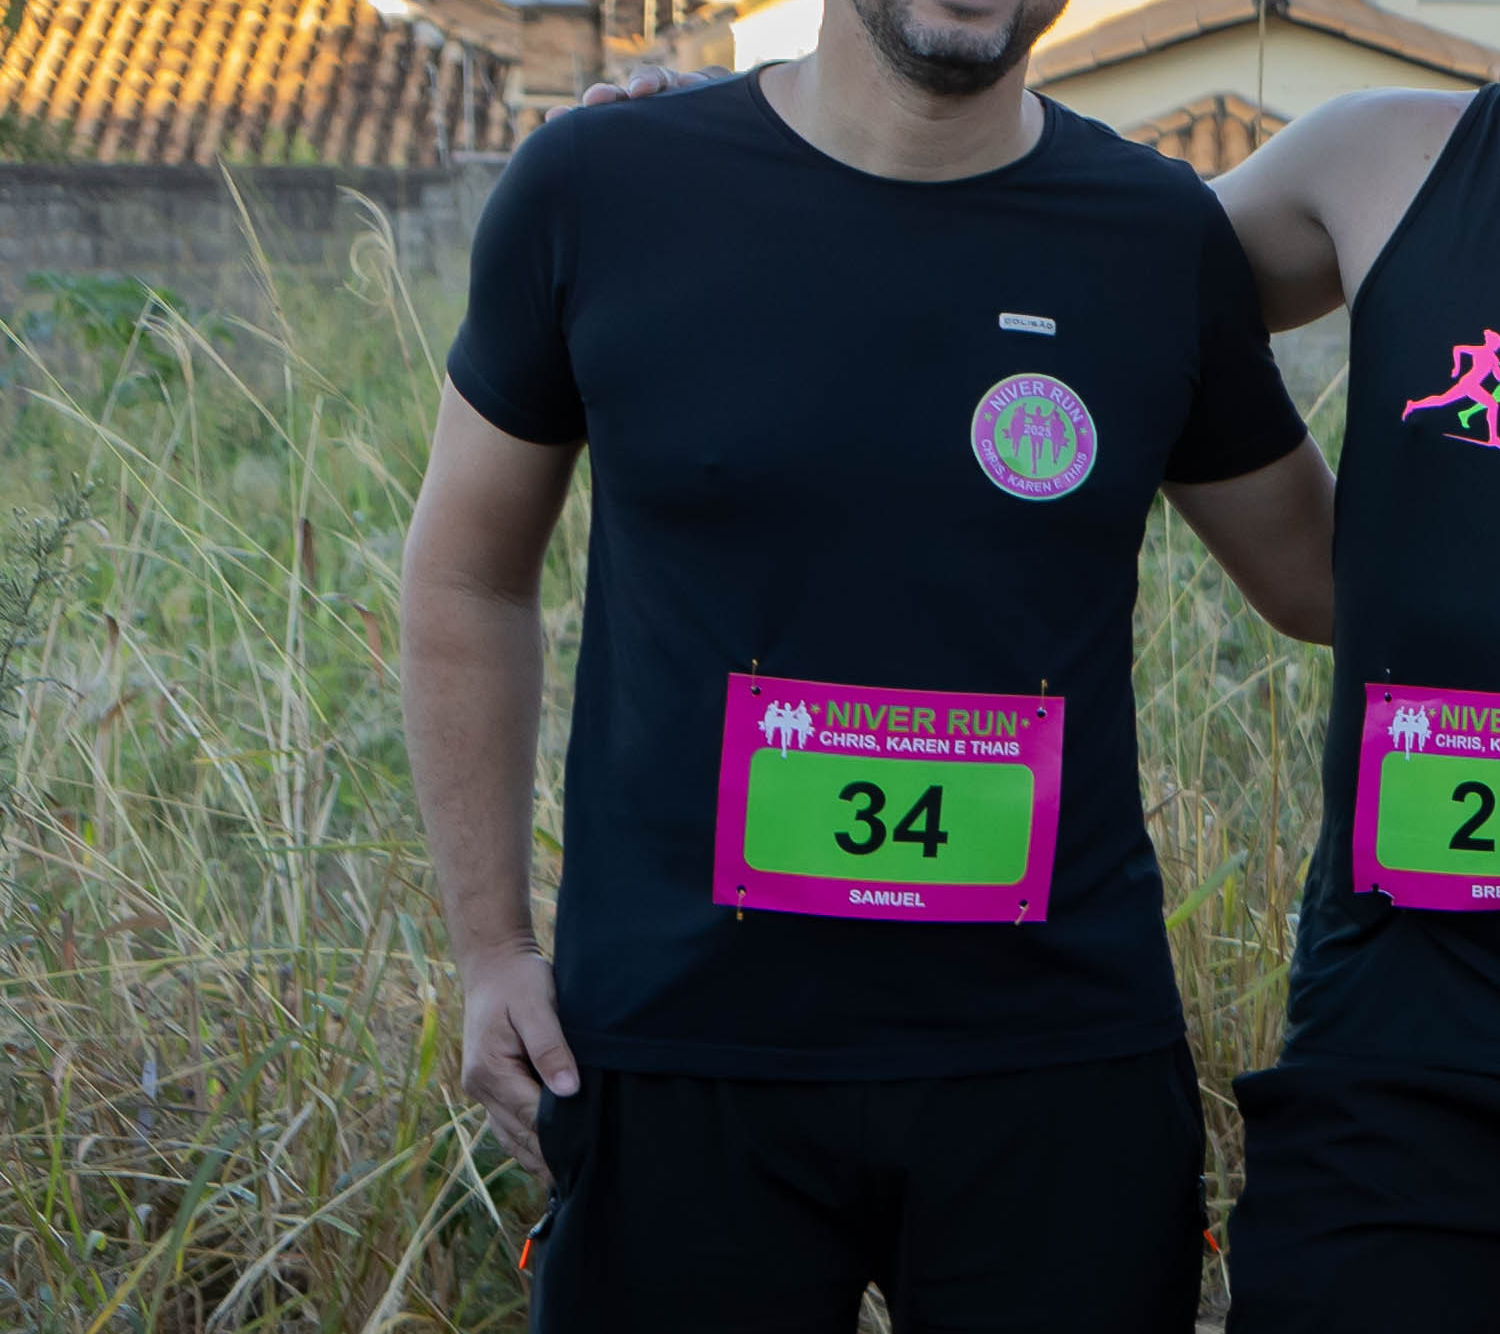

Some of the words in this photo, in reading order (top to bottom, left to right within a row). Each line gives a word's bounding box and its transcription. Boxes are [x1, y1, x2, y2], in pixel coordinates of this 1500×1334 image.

[990, 381, 1045, 412] NIVER
[1051, 386, 1083, 423] RUN
[1024, 424, 1051, 437] 2025
[1008, 475, 1051, 492] KAREN
[1055, 479, 1063, 489] E
[1065, 452, 1087, 483] THAIS
[826, 700, 936, 734] NIVER
[947, 709, 1018, 737] RUN
[819, 731, 881, 751] CHRIS,
[886, 737, 949, 754] KAREN
[955, 740, 965, 754] E
[970, 740, 1020, 756] THAIS
[1435, 734, 1486, 753] CHRIS,
[834, 781, 948, 858] 34
[849, 889, 926, 907] SAMUEL
